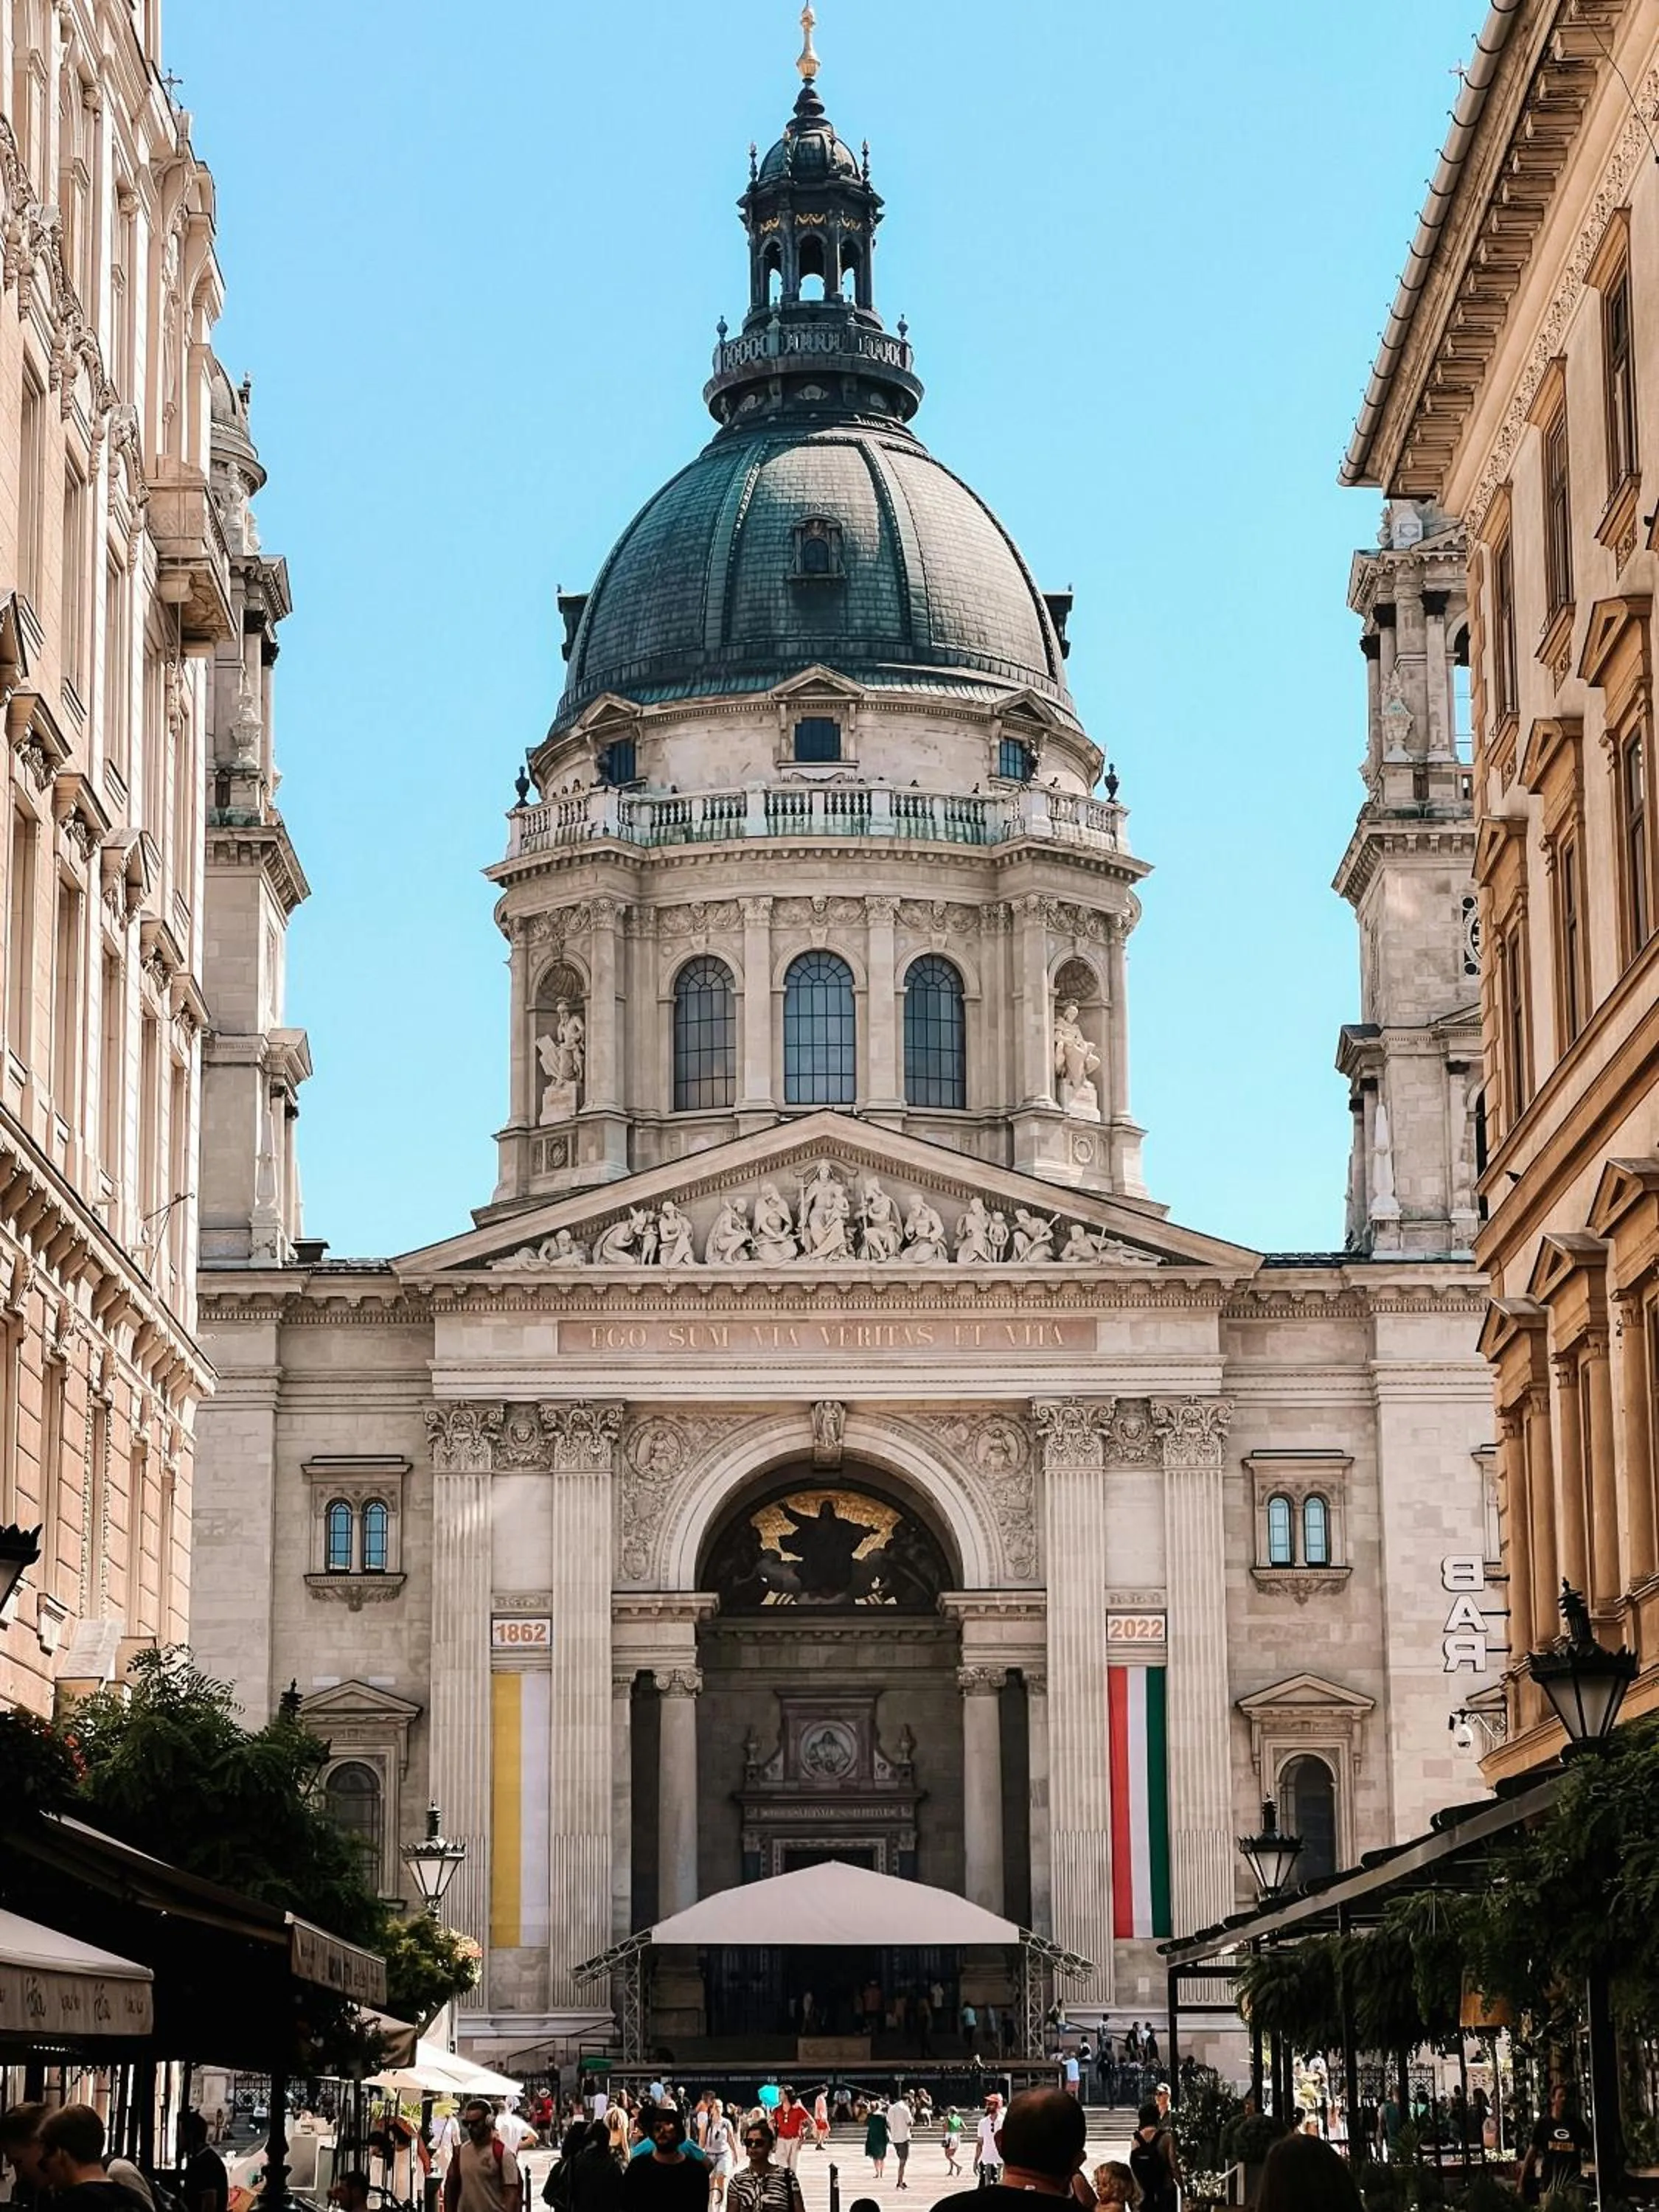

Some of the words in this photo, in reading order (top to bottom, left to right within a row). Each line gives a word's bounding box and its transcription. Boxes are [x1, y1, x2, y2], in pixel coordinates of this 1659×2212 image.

[591, 1327, 647, 1348] EGO
[669, 1327, 730, 1348] SUM
[752, 1326, 801, 1348] VIA
[819, 1326, 935, 1347] VERITAS
[954, 1326, 987, 1346] ET
[1005, 1326, 1065, 1347] VITA
[495, 1624, 546, 1643] 1862
[1110, 1619, 1164, 1638] 2022
